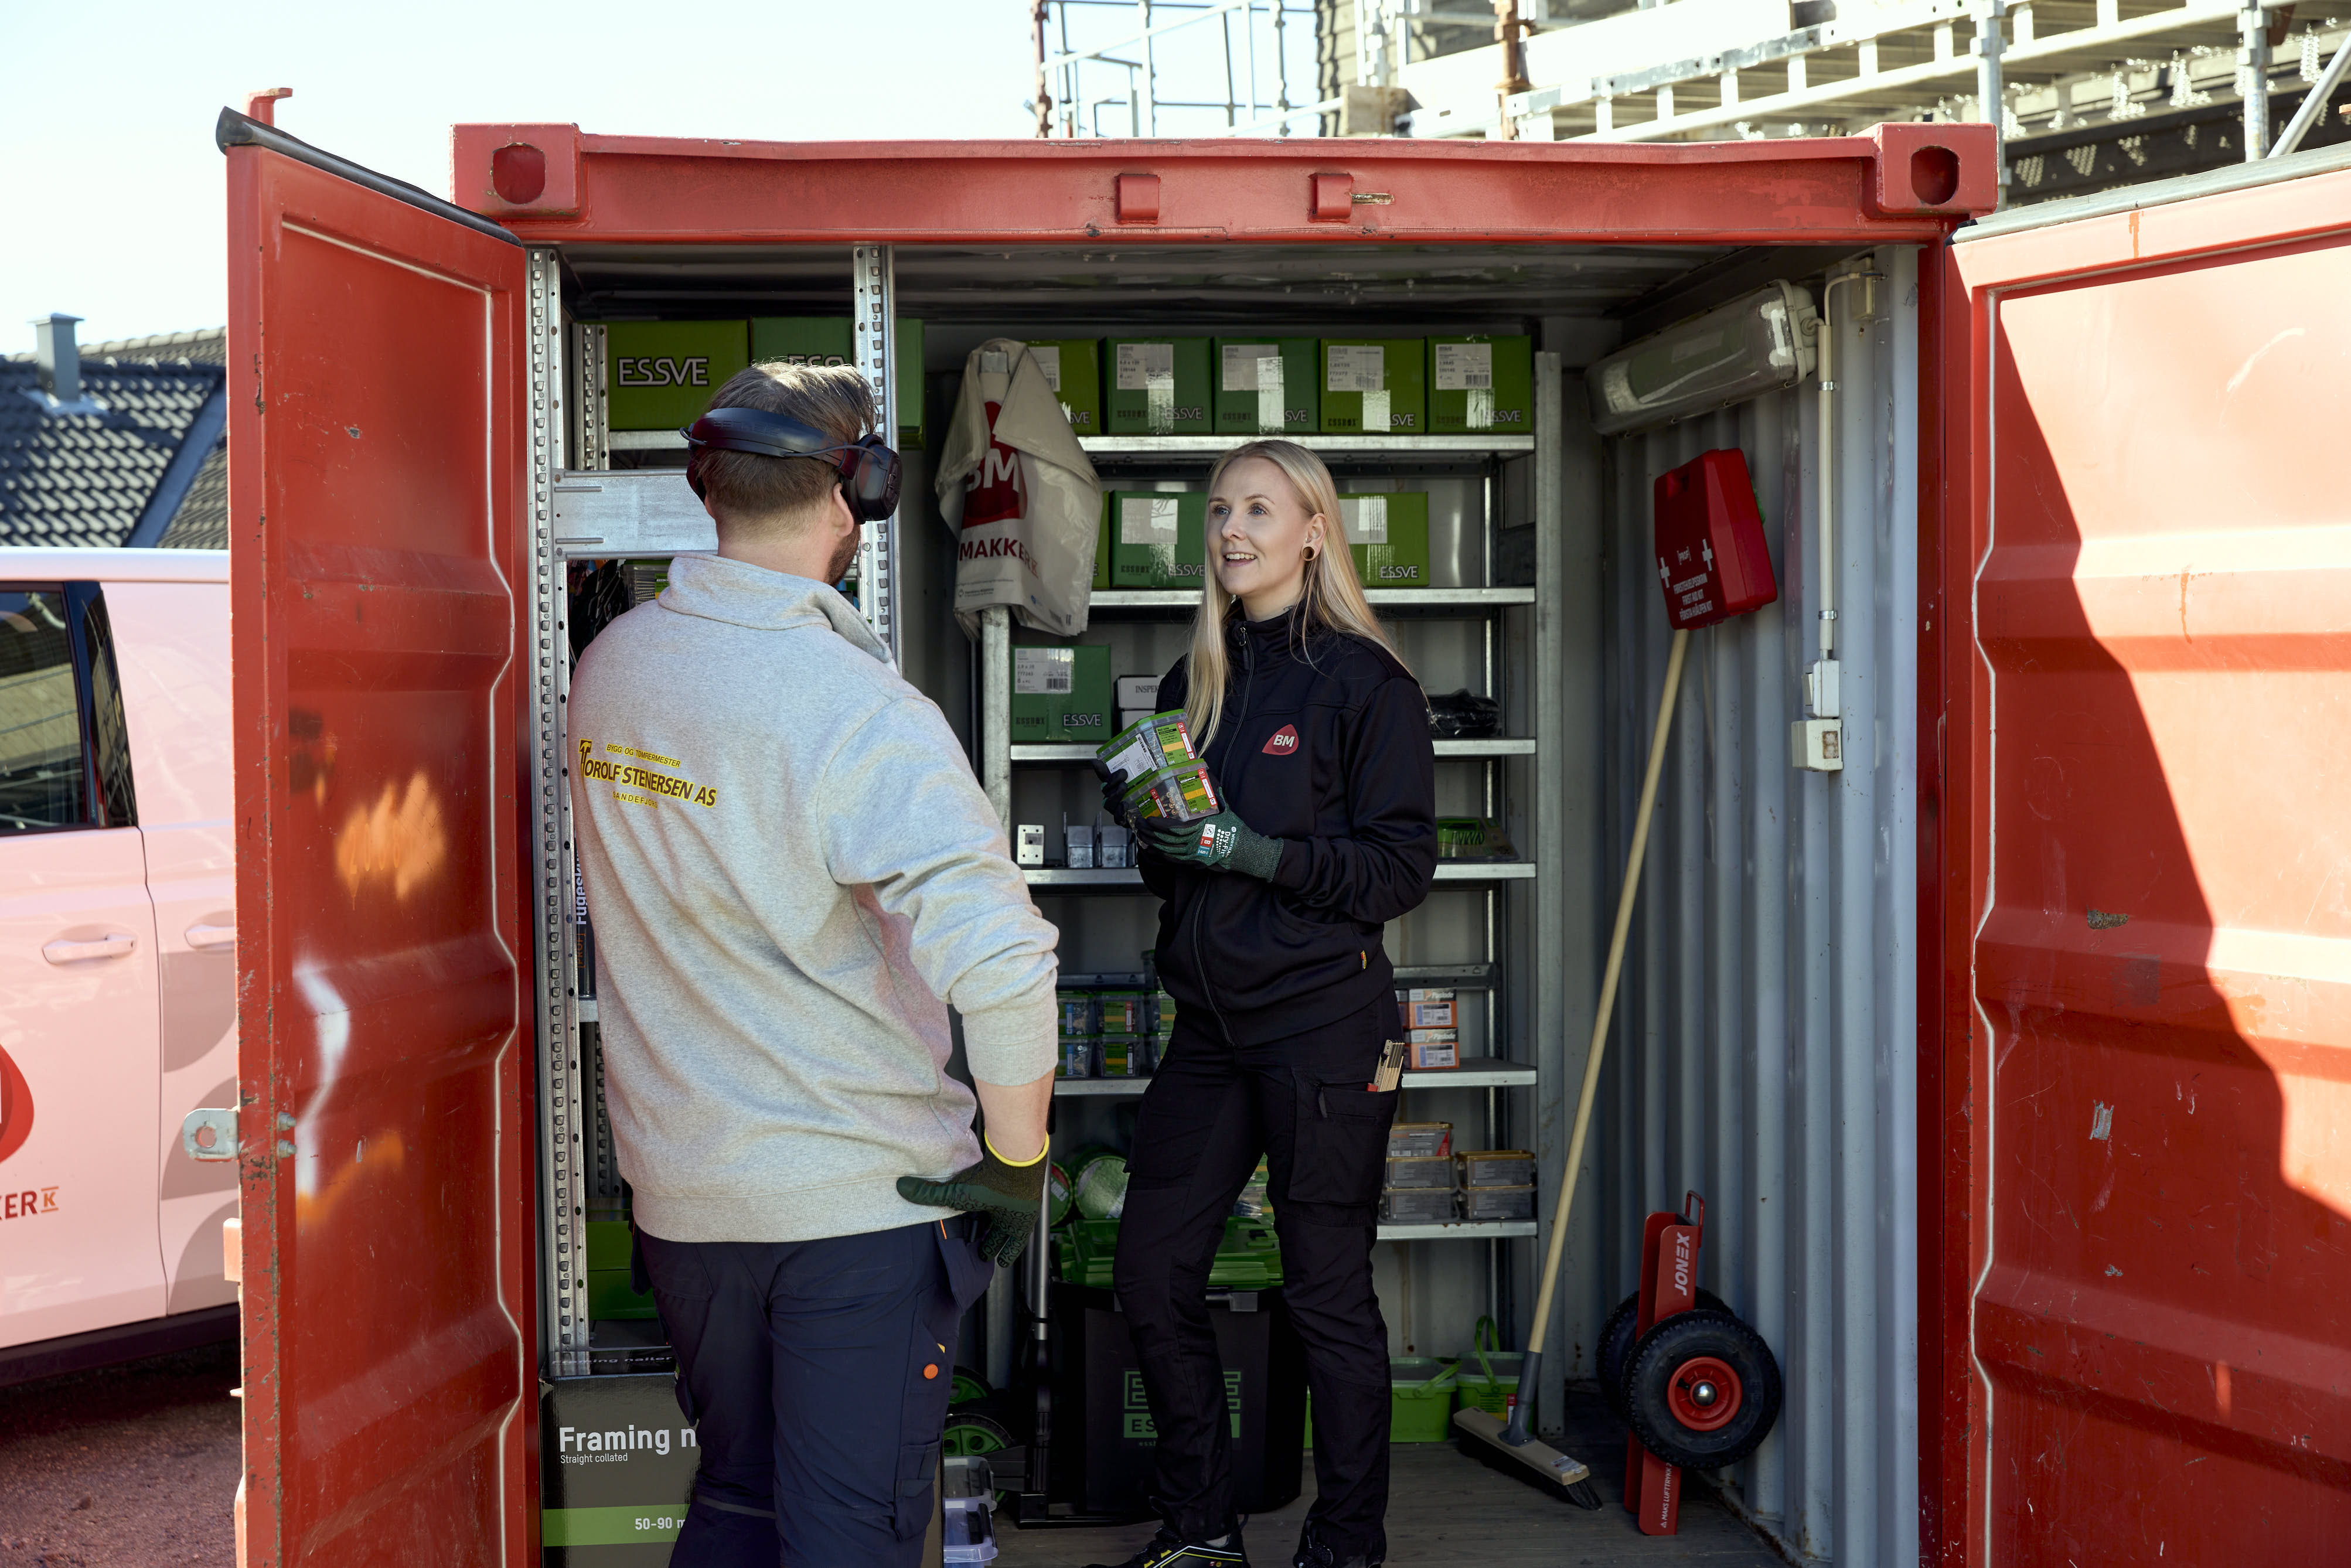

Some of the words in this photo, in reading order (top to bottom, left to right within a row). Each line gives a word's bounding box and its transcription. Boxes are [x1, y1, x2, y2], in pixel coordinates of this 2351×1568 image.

[617, 357, 709, 387] ESSVE
[1379, 565, 1419, 579] ESSVE
[1682, 595, 1692, 605] FIRST
[1063, 713, 1102, 727] ESSVE
[1273, 734, 1295, 747] BM
[606, 743, 623, 754] BYGG
[624, 747, 634, 756] OG
[635, 749, 681, 768] TØMRERMESTER
[621, 765, 695, 801] STENERSEN
[693, 785, 718, 808] AS
[1674, 1232, 1691, 1296] JONEX
[560, 1424, 670, 1455] Framing
[560, 1454, 592, 1465] Straight
[595, 1453, 628, 1463] collated
[1664, 1467, 1672, 1502] LUFTTRYKK
[635, 1517, 673, 1530] 50-90
